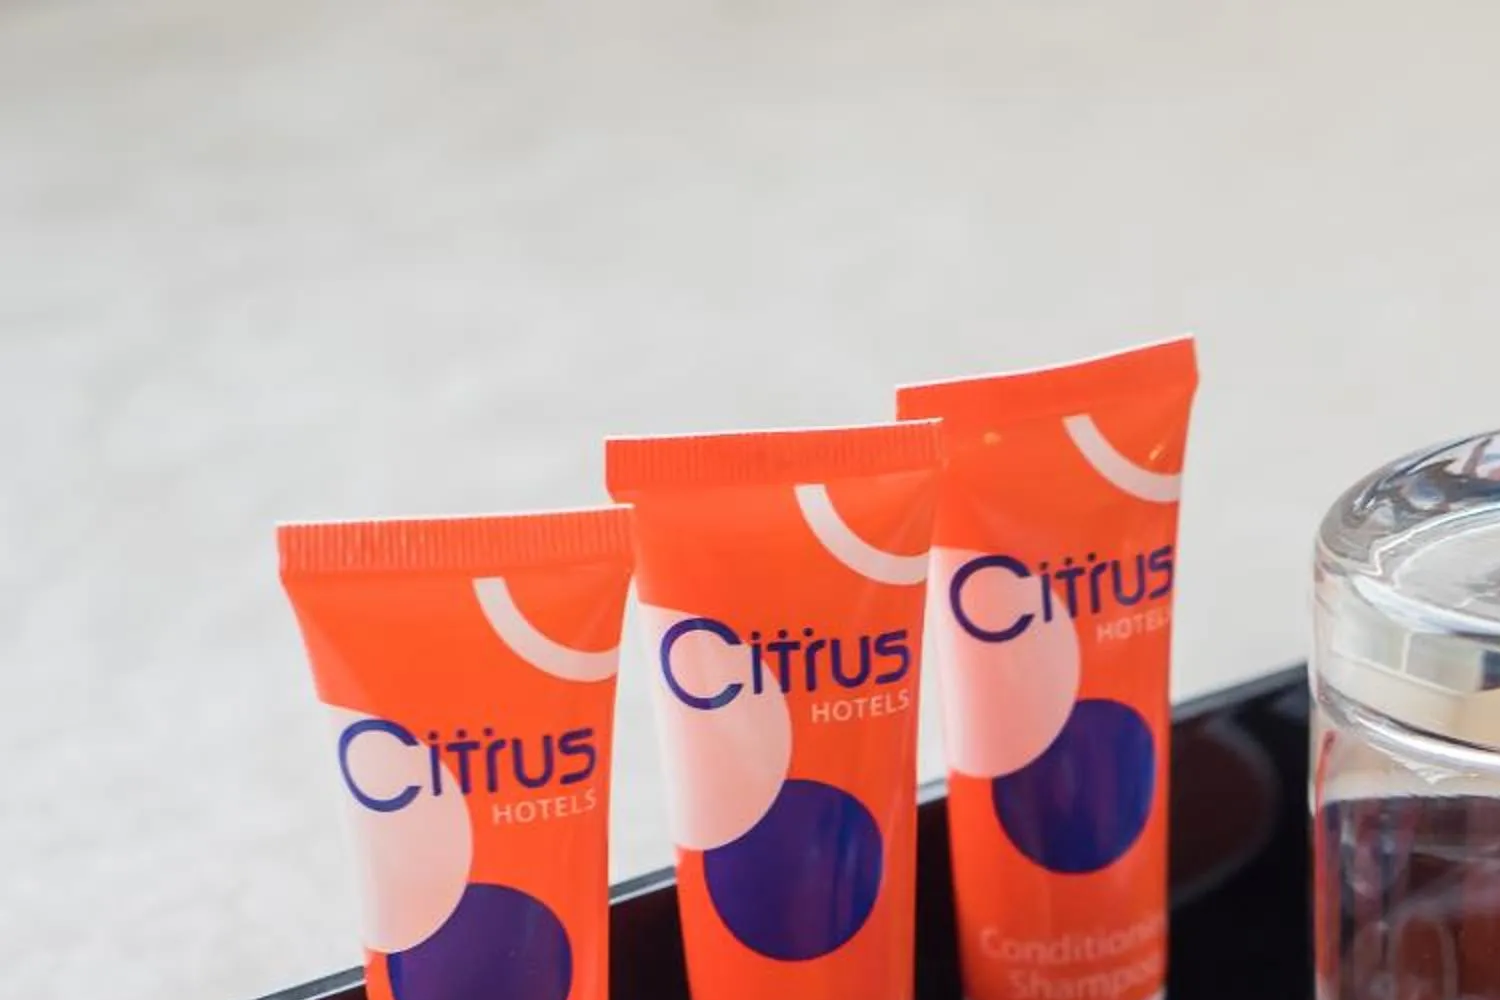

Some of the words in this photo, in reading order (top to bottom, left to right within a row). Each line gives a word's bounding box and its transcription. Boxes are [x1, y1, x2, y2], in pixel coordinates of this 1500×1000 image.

[950, 544, 1176, 644] Citrus
[1096, 605, 1172, 645] HOTEL
[660, 616, 911, 711] Citrus
[810, 688, 910, 724] HOTELS
[337, 718, 597, 813] Citrus
[491, 787, 597, 826] HOTELS
